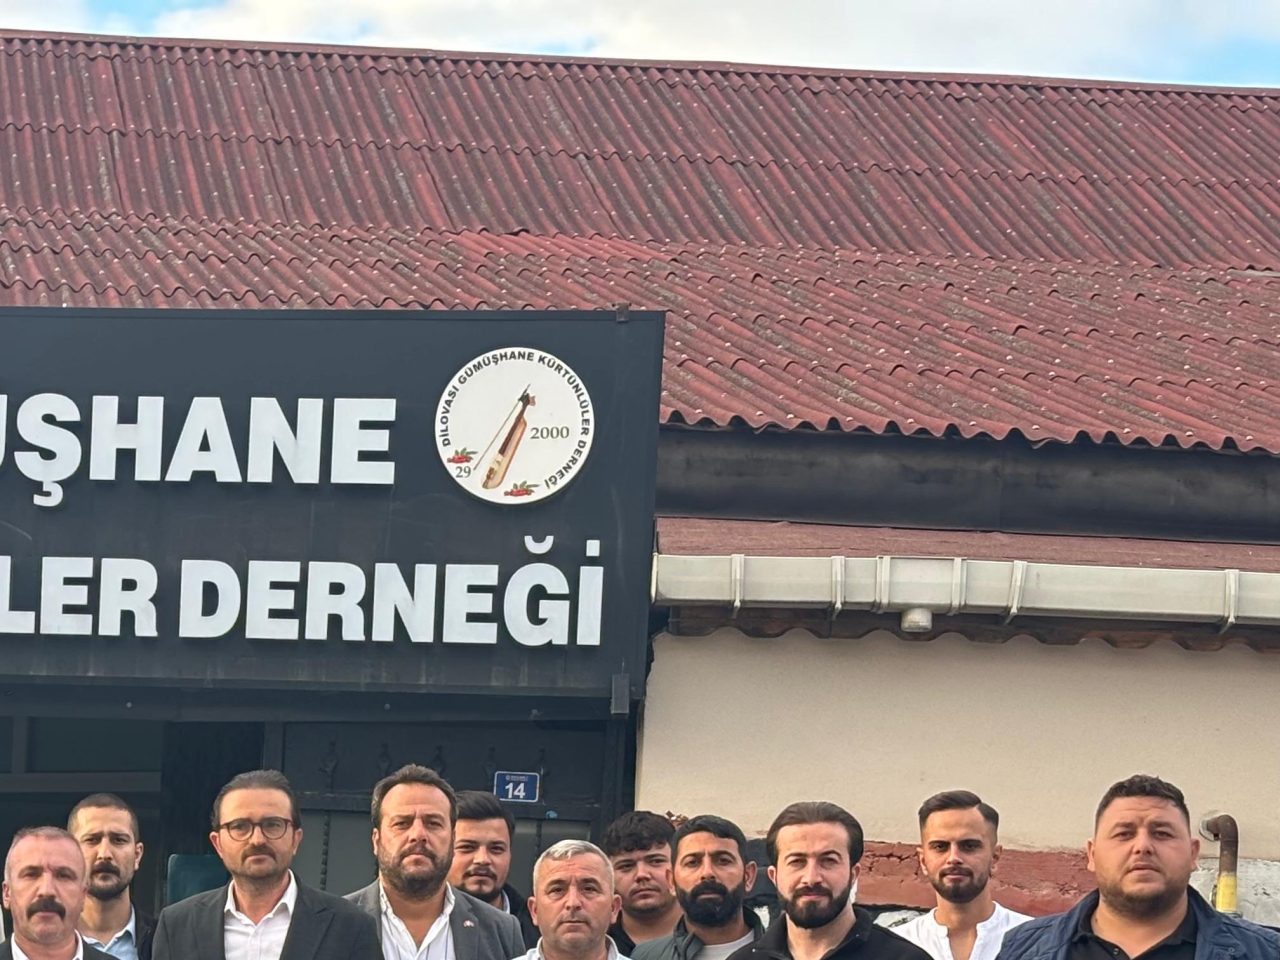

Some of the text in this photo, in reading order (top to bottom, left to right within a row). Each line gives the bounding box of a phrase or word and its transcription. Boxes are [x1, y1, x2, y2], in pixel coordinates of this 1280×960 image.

[458, 351, 534, 385] GÜMÜŞHANE
[537, 355, 591, 436] KÜRTÜNLÜLER
[530, 426, 570, 439] 2000
[455, 466, 471, 478] 29
[179, 535, 604, 647] DERNEĞİ
[505, 782, 526, 799] 14
